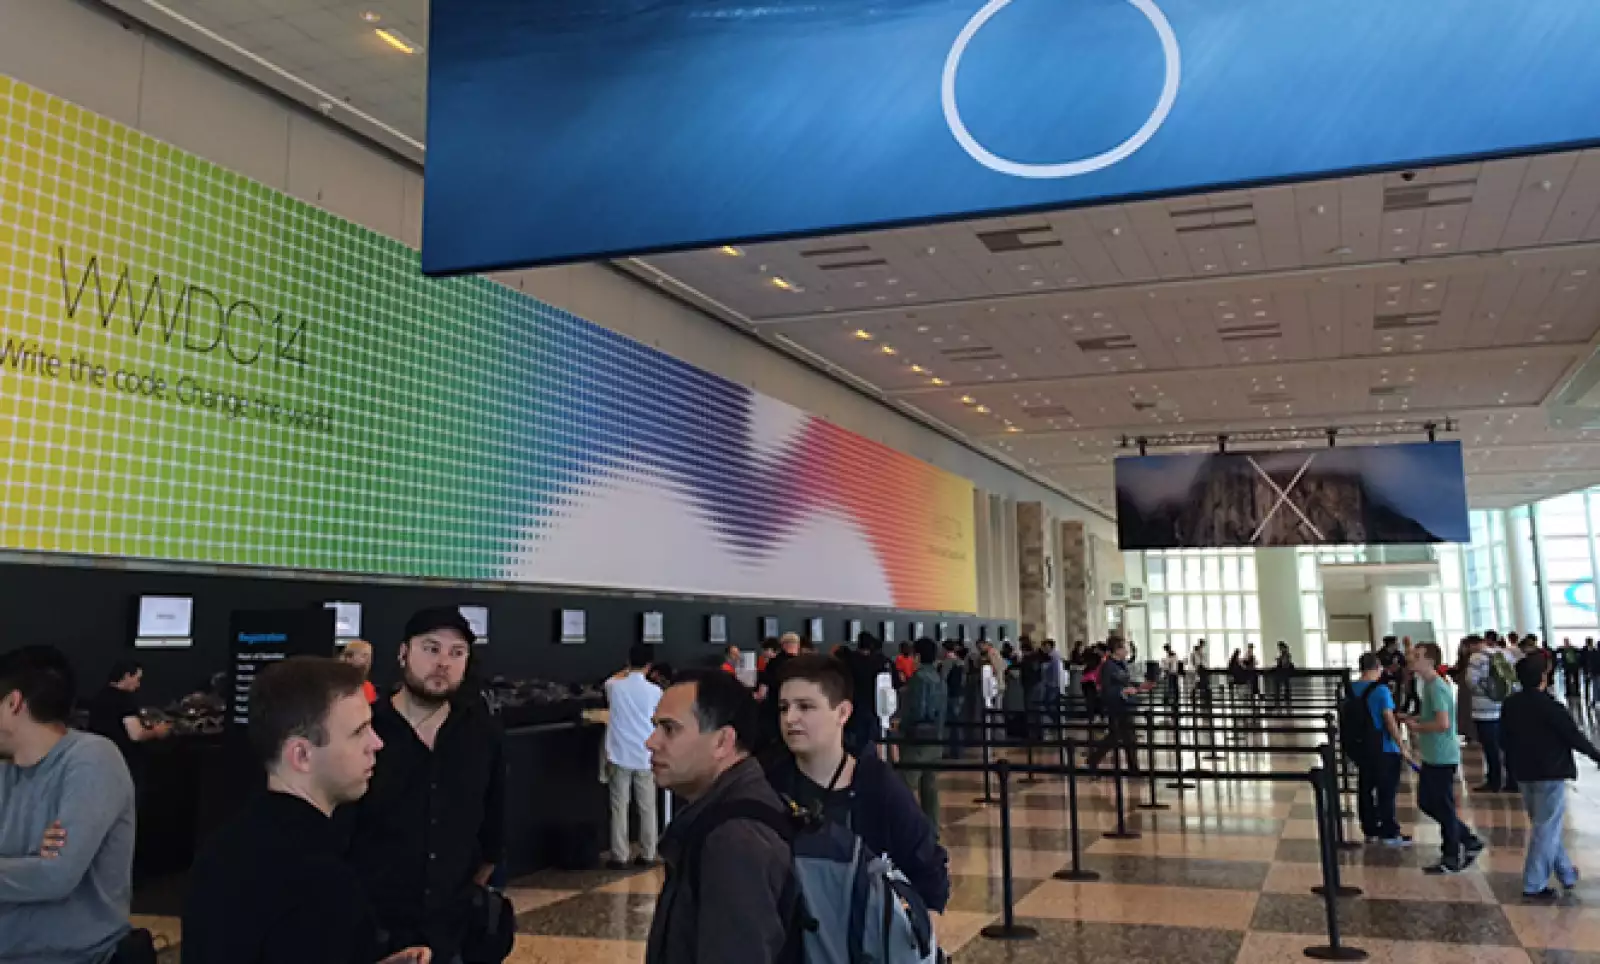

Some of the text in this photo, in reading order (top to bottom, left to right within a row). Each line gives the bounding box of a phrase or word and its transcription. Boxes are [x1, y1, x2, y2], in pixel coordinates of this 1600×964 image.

[0, 338, 60, 378] Write
[70, 355, 106, 389] the
[113, 369, 171, 401] code.
[176, 376, 249, 420] Change
